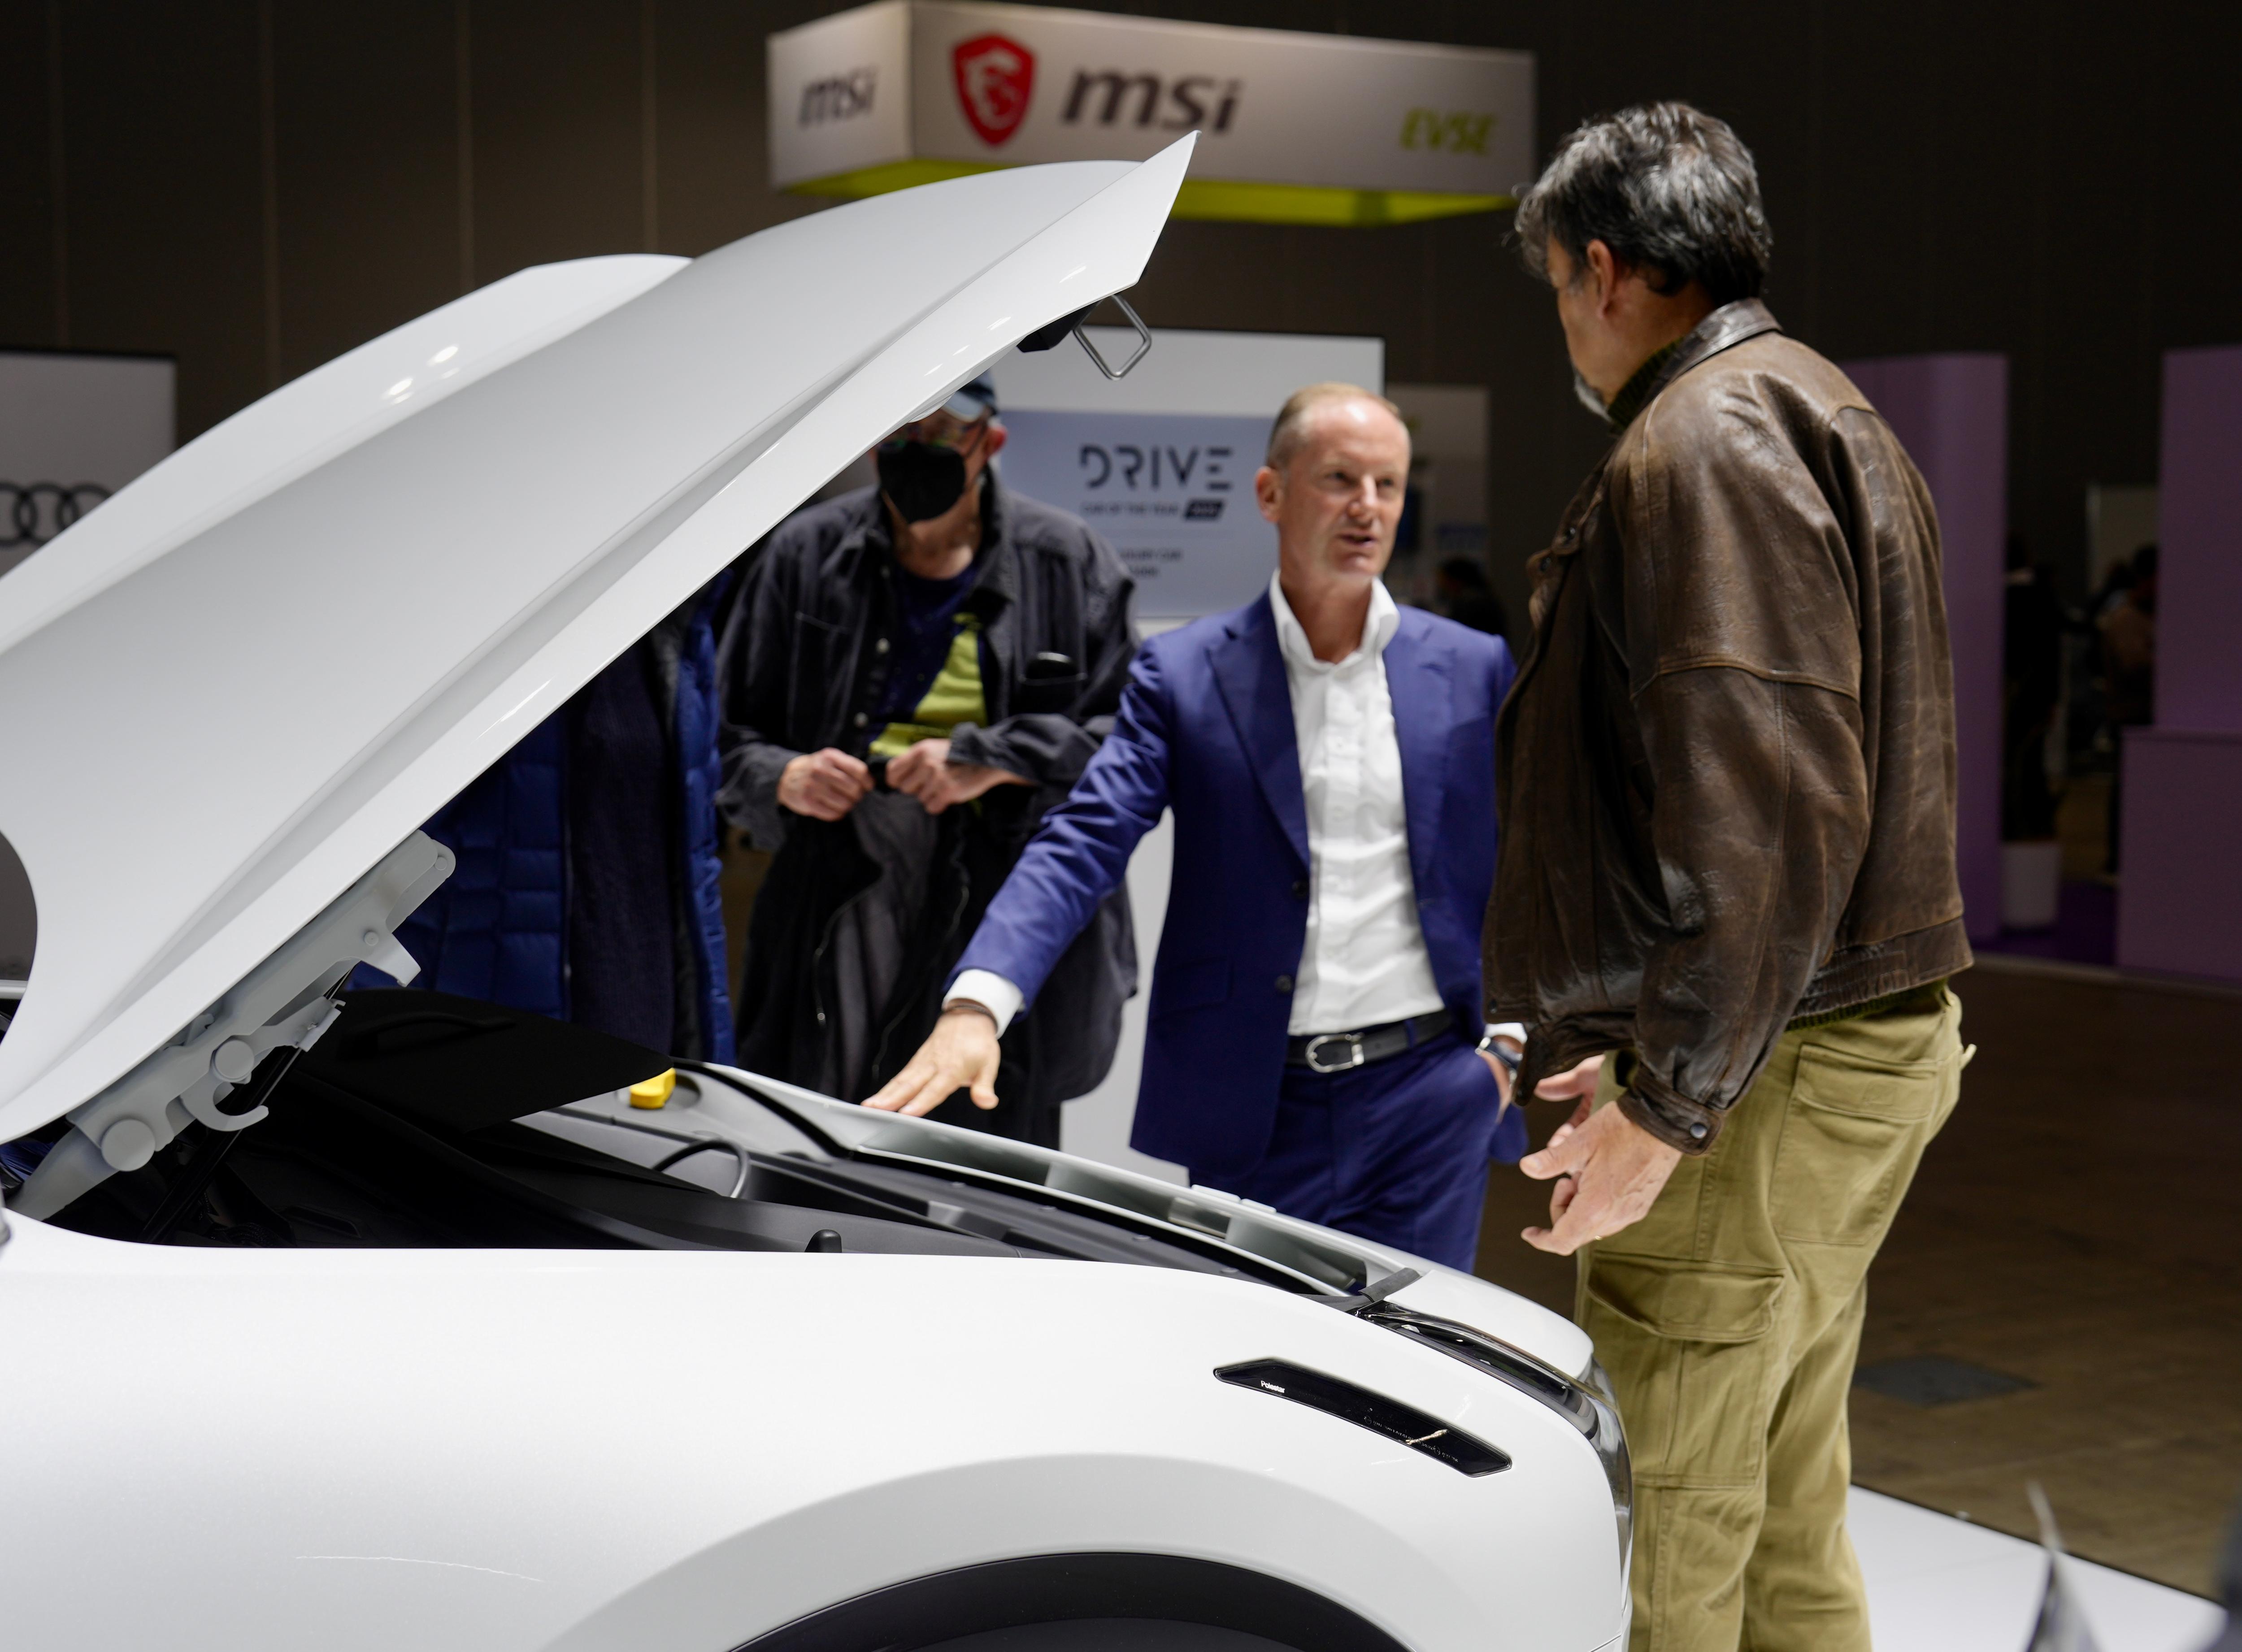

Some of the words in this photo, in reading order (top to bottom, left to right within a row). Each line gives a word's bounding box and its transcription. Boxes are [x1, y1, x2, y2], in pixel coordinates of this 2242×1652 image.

[797, 65, 877, 129] msi
[1062, 68, 1242, 134] msi
[1400, 108, 1495, 154] EVSE
[1080, 444, 1233, 491] DRIVE
[1260, 1380, 1285, 1393] Polestar
